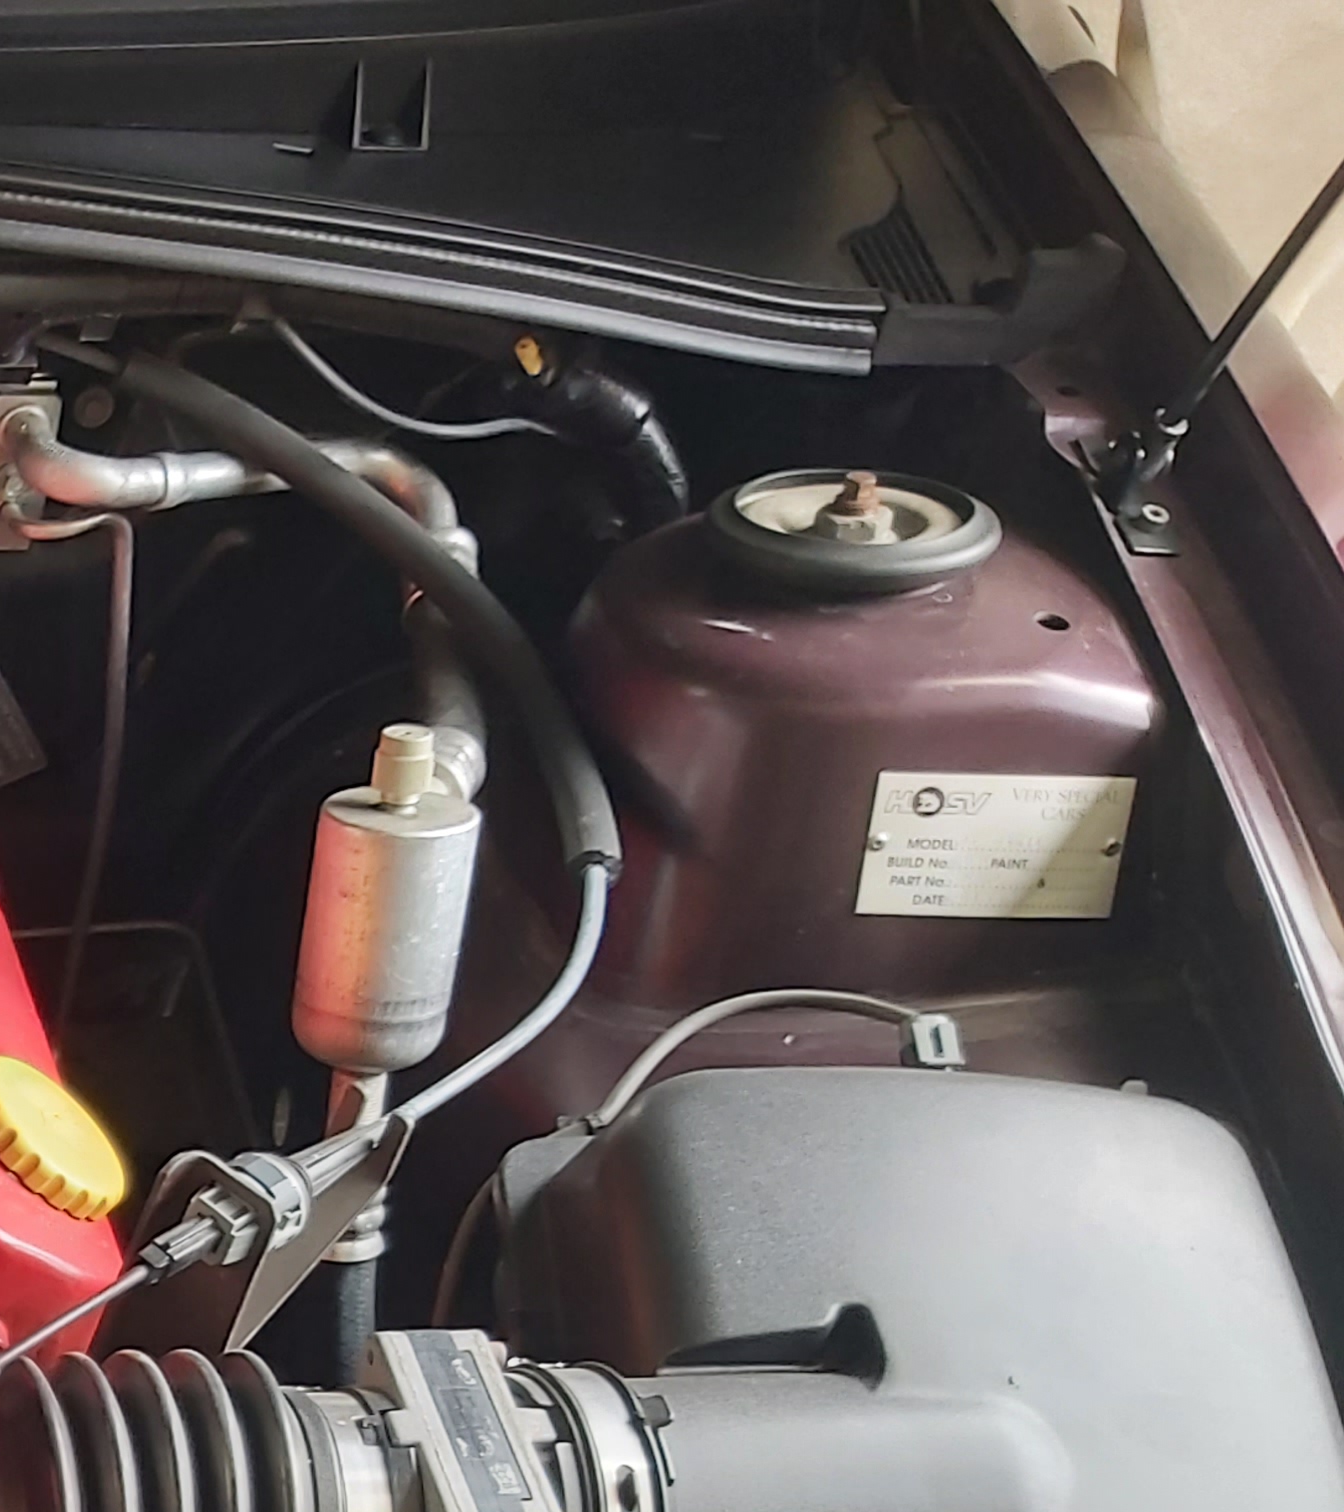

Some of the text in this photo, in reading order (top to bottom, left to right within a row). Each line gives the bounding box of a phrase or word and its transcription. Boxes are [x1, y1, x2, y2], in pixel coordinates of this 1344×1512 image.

[907, 839, 954, 850] MODEL
[887, 857, 923, 868] BUILD
[991, 859, 1028, 869] PAINT
[889, 876, 922, 886] PART
[912, 895, 945, 906] DATE
